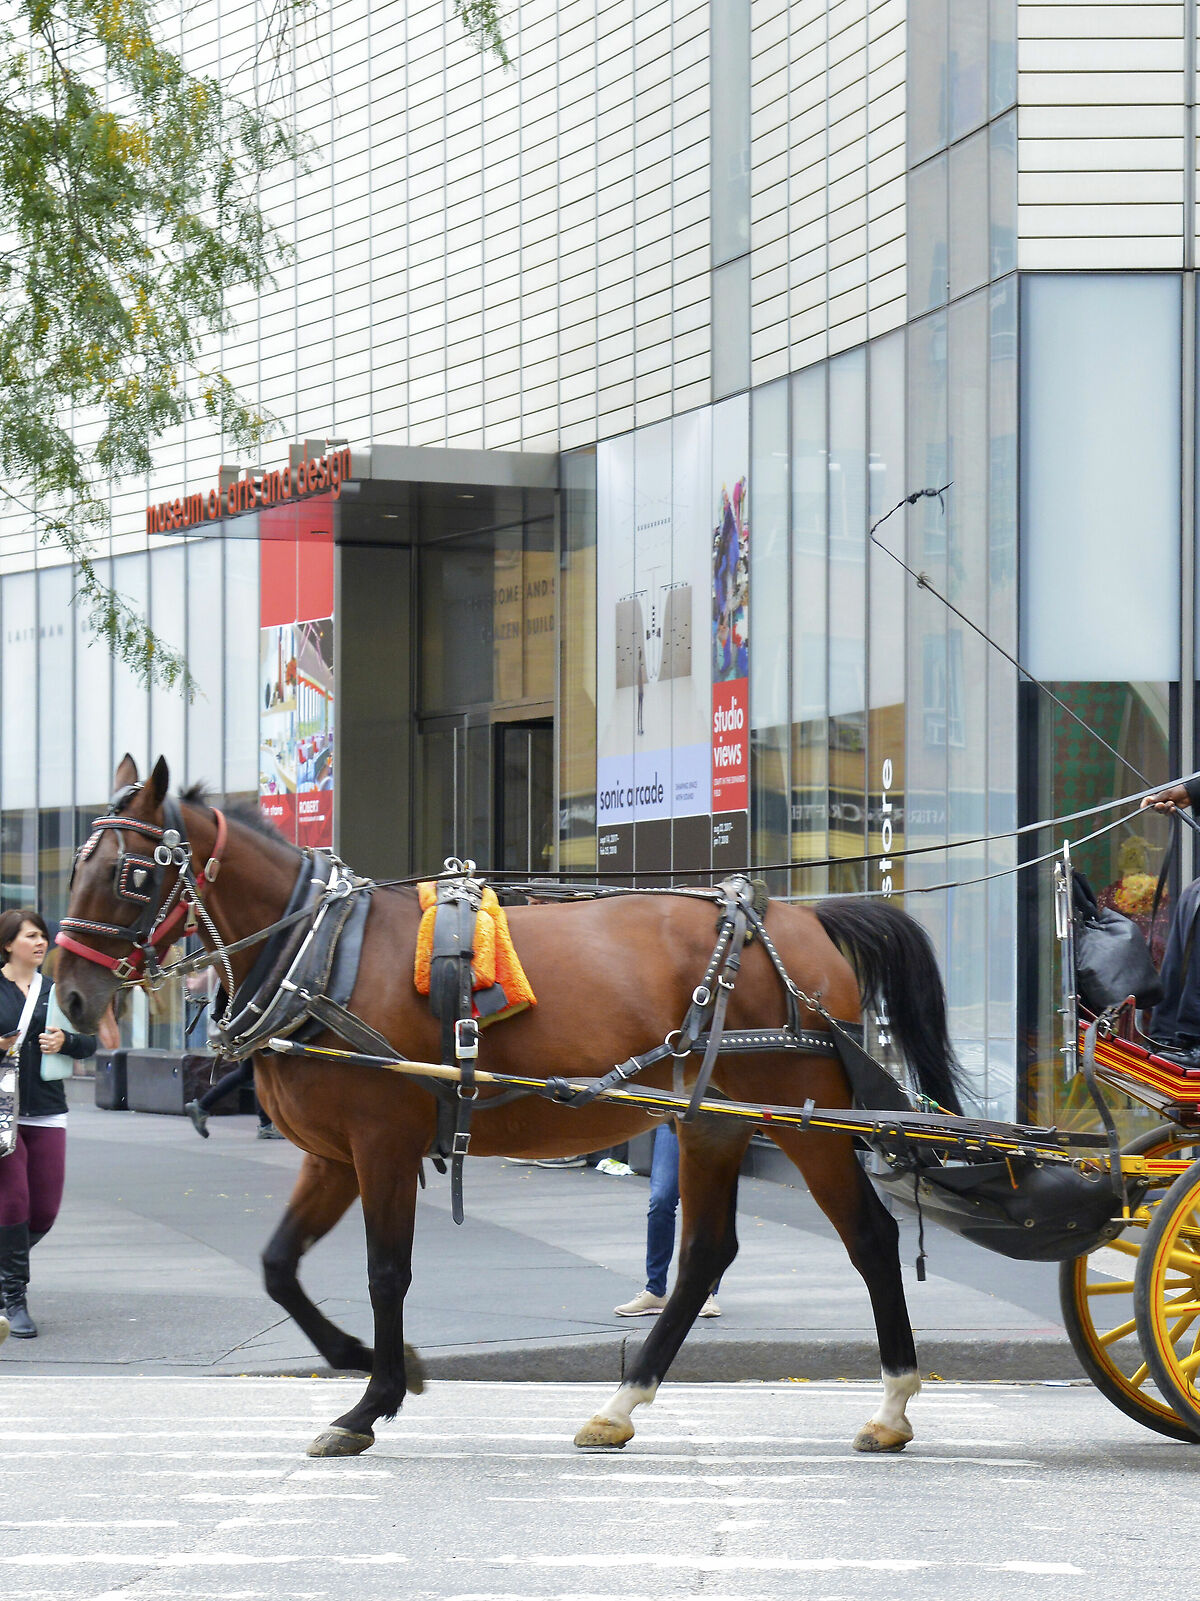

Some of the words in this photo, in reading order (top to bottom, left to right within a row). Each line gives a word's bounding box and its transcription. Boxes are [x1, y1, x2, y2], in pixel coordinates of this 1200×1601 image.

[146, 491, 204, 535] museum
[207, 465, 223, 520] of
[227, 468, 256, 514] arts
[260, 444, 293, 502] and
[296, 439, 352, 500] design
[714, 696, 744, 733] studio
[714, 736, 742, 767] views
[600, 779, 624, 811] sonic
[626, 771, 664, 807] arcade
[879, 758, 893, 898] store
